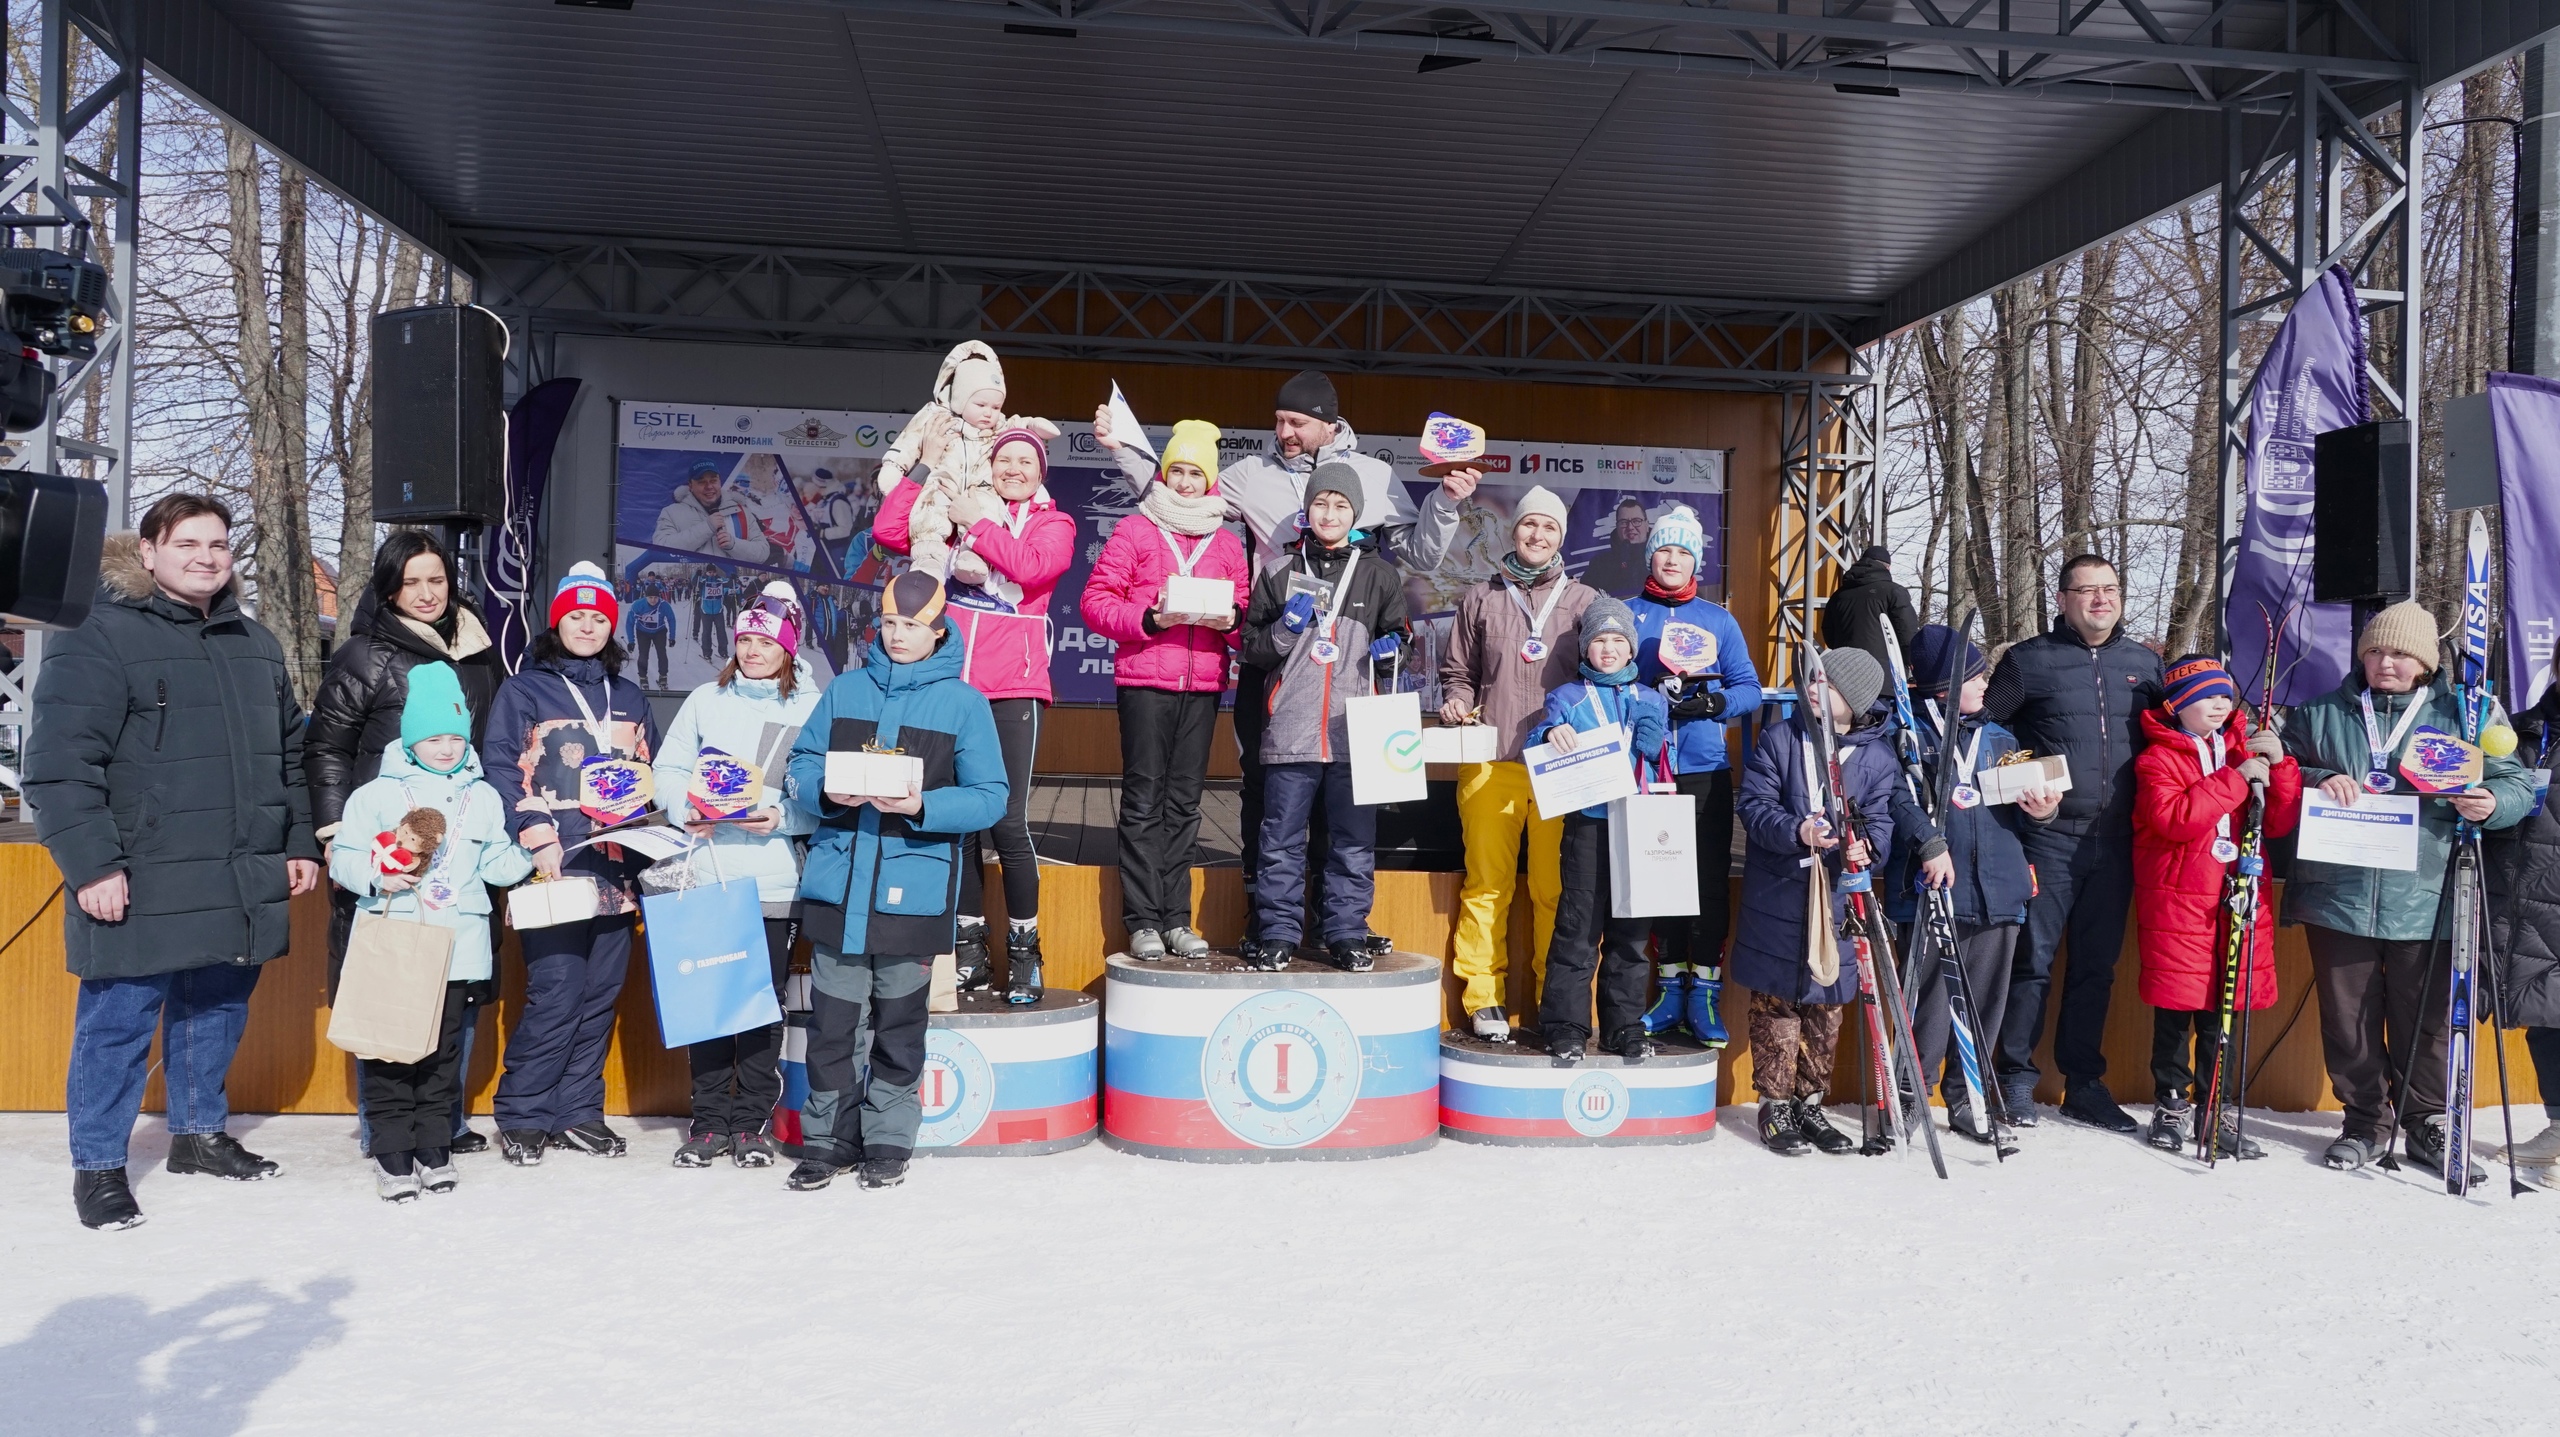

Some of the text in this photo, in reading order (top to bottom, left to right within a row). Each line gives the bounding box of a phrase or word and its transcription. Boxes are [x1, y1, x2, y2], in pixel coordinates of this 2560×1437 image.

[633, 411, 702, 427] ESTEL
[712, 435, 773, 446] ГАЗПРОМБАНК
[788, 439, 837, 447] РОСГОССТРАХ
[1546, 458, 1583, 473] ПСБ
[1597, 460, 1643, 471] BRIGHT
[707, 588, 721, 596] 200
[2467, 582, 2487, 657] TISA
[1544, 746, 1610, 771] ДИПЛОМ ПРИЗЕРА
[2321, 809, 2400, 822] ДИПЛОМ ПРИЗЕРА
[697, 950, 748, 969] ГАЗПРОМБАНК
[1274, 1043, 1292, 1094] I
[1587, 1095, 1606, 1111] III
